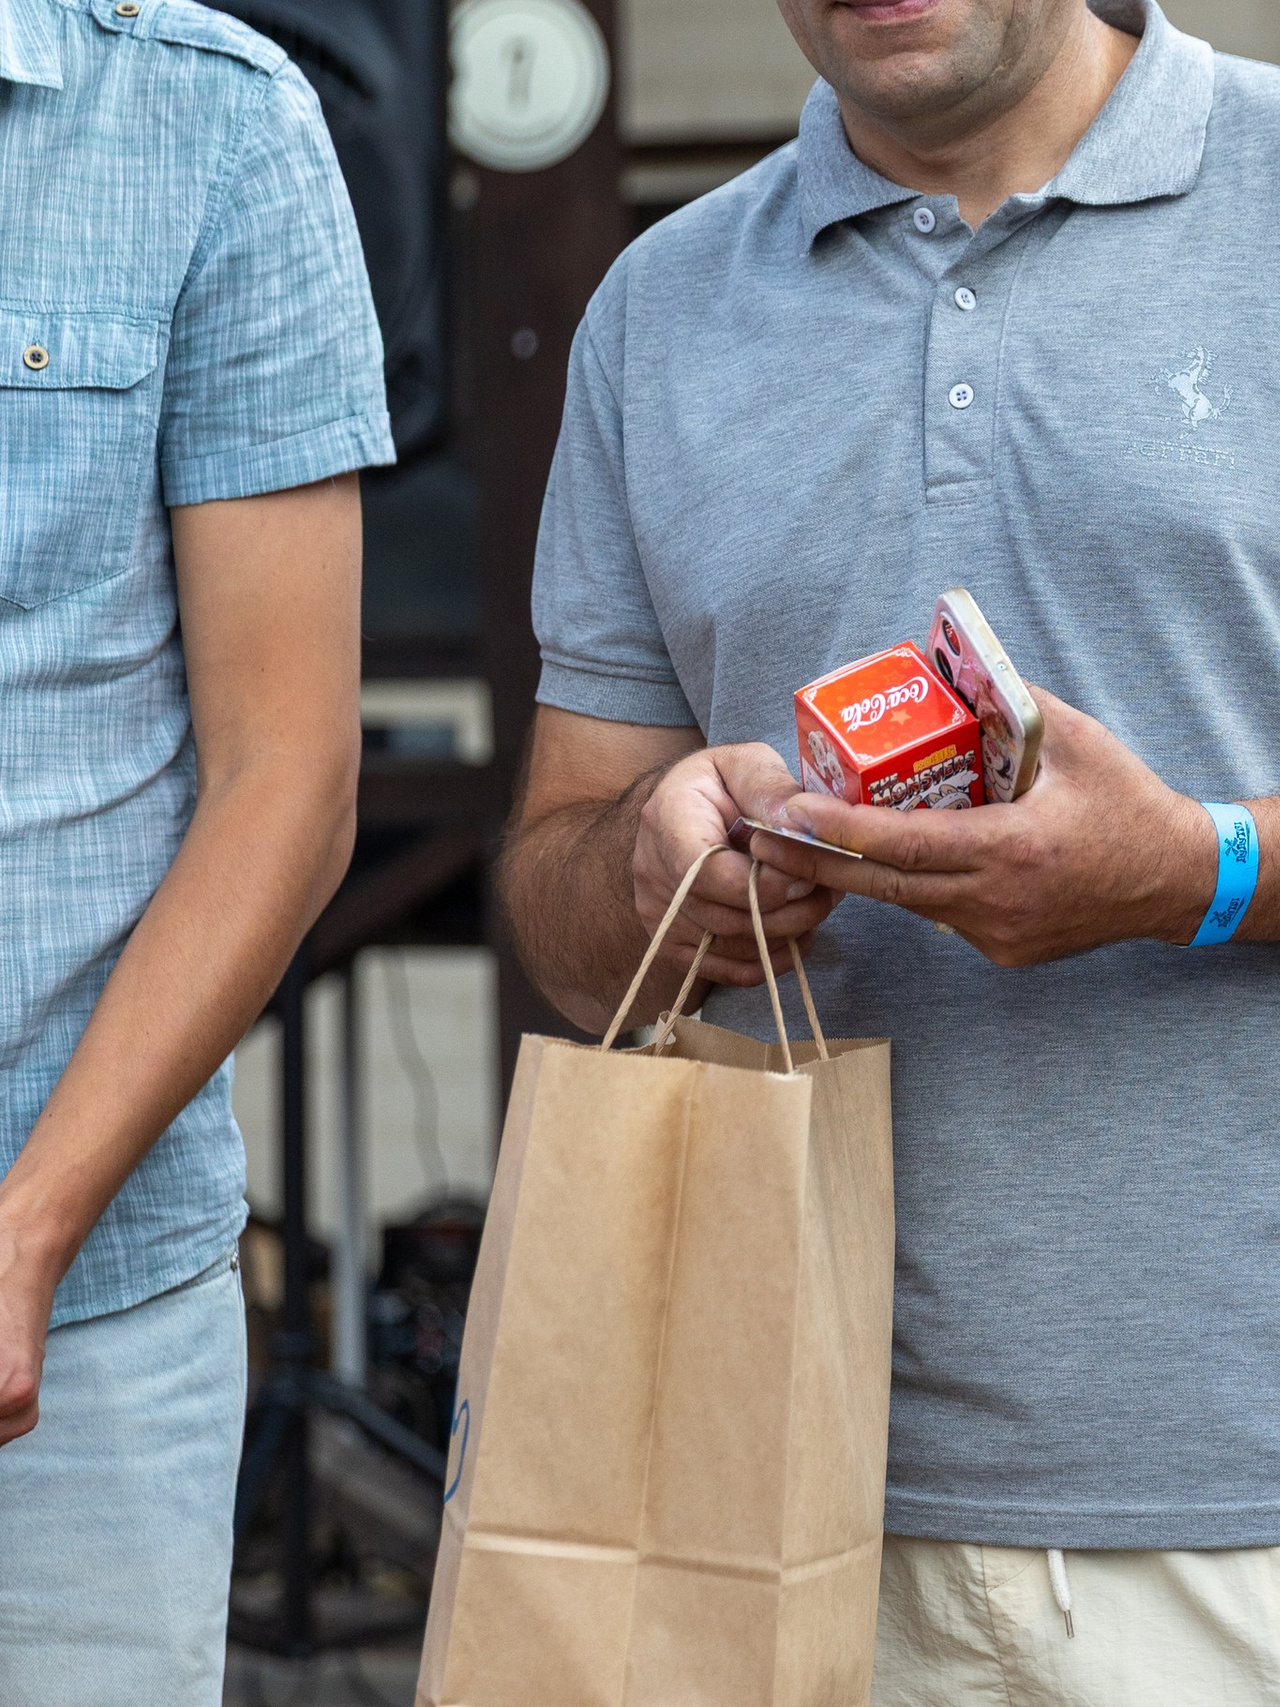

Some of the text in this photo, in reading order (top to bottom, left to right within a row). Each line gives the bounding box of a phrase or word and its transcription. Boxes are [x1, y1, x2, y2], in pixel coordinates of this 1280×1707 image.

[840, 676, 929, 733] Coca-Cola
[868, 773, 899, 792] THE
[871, 750, 976, 805] MONSTERS
